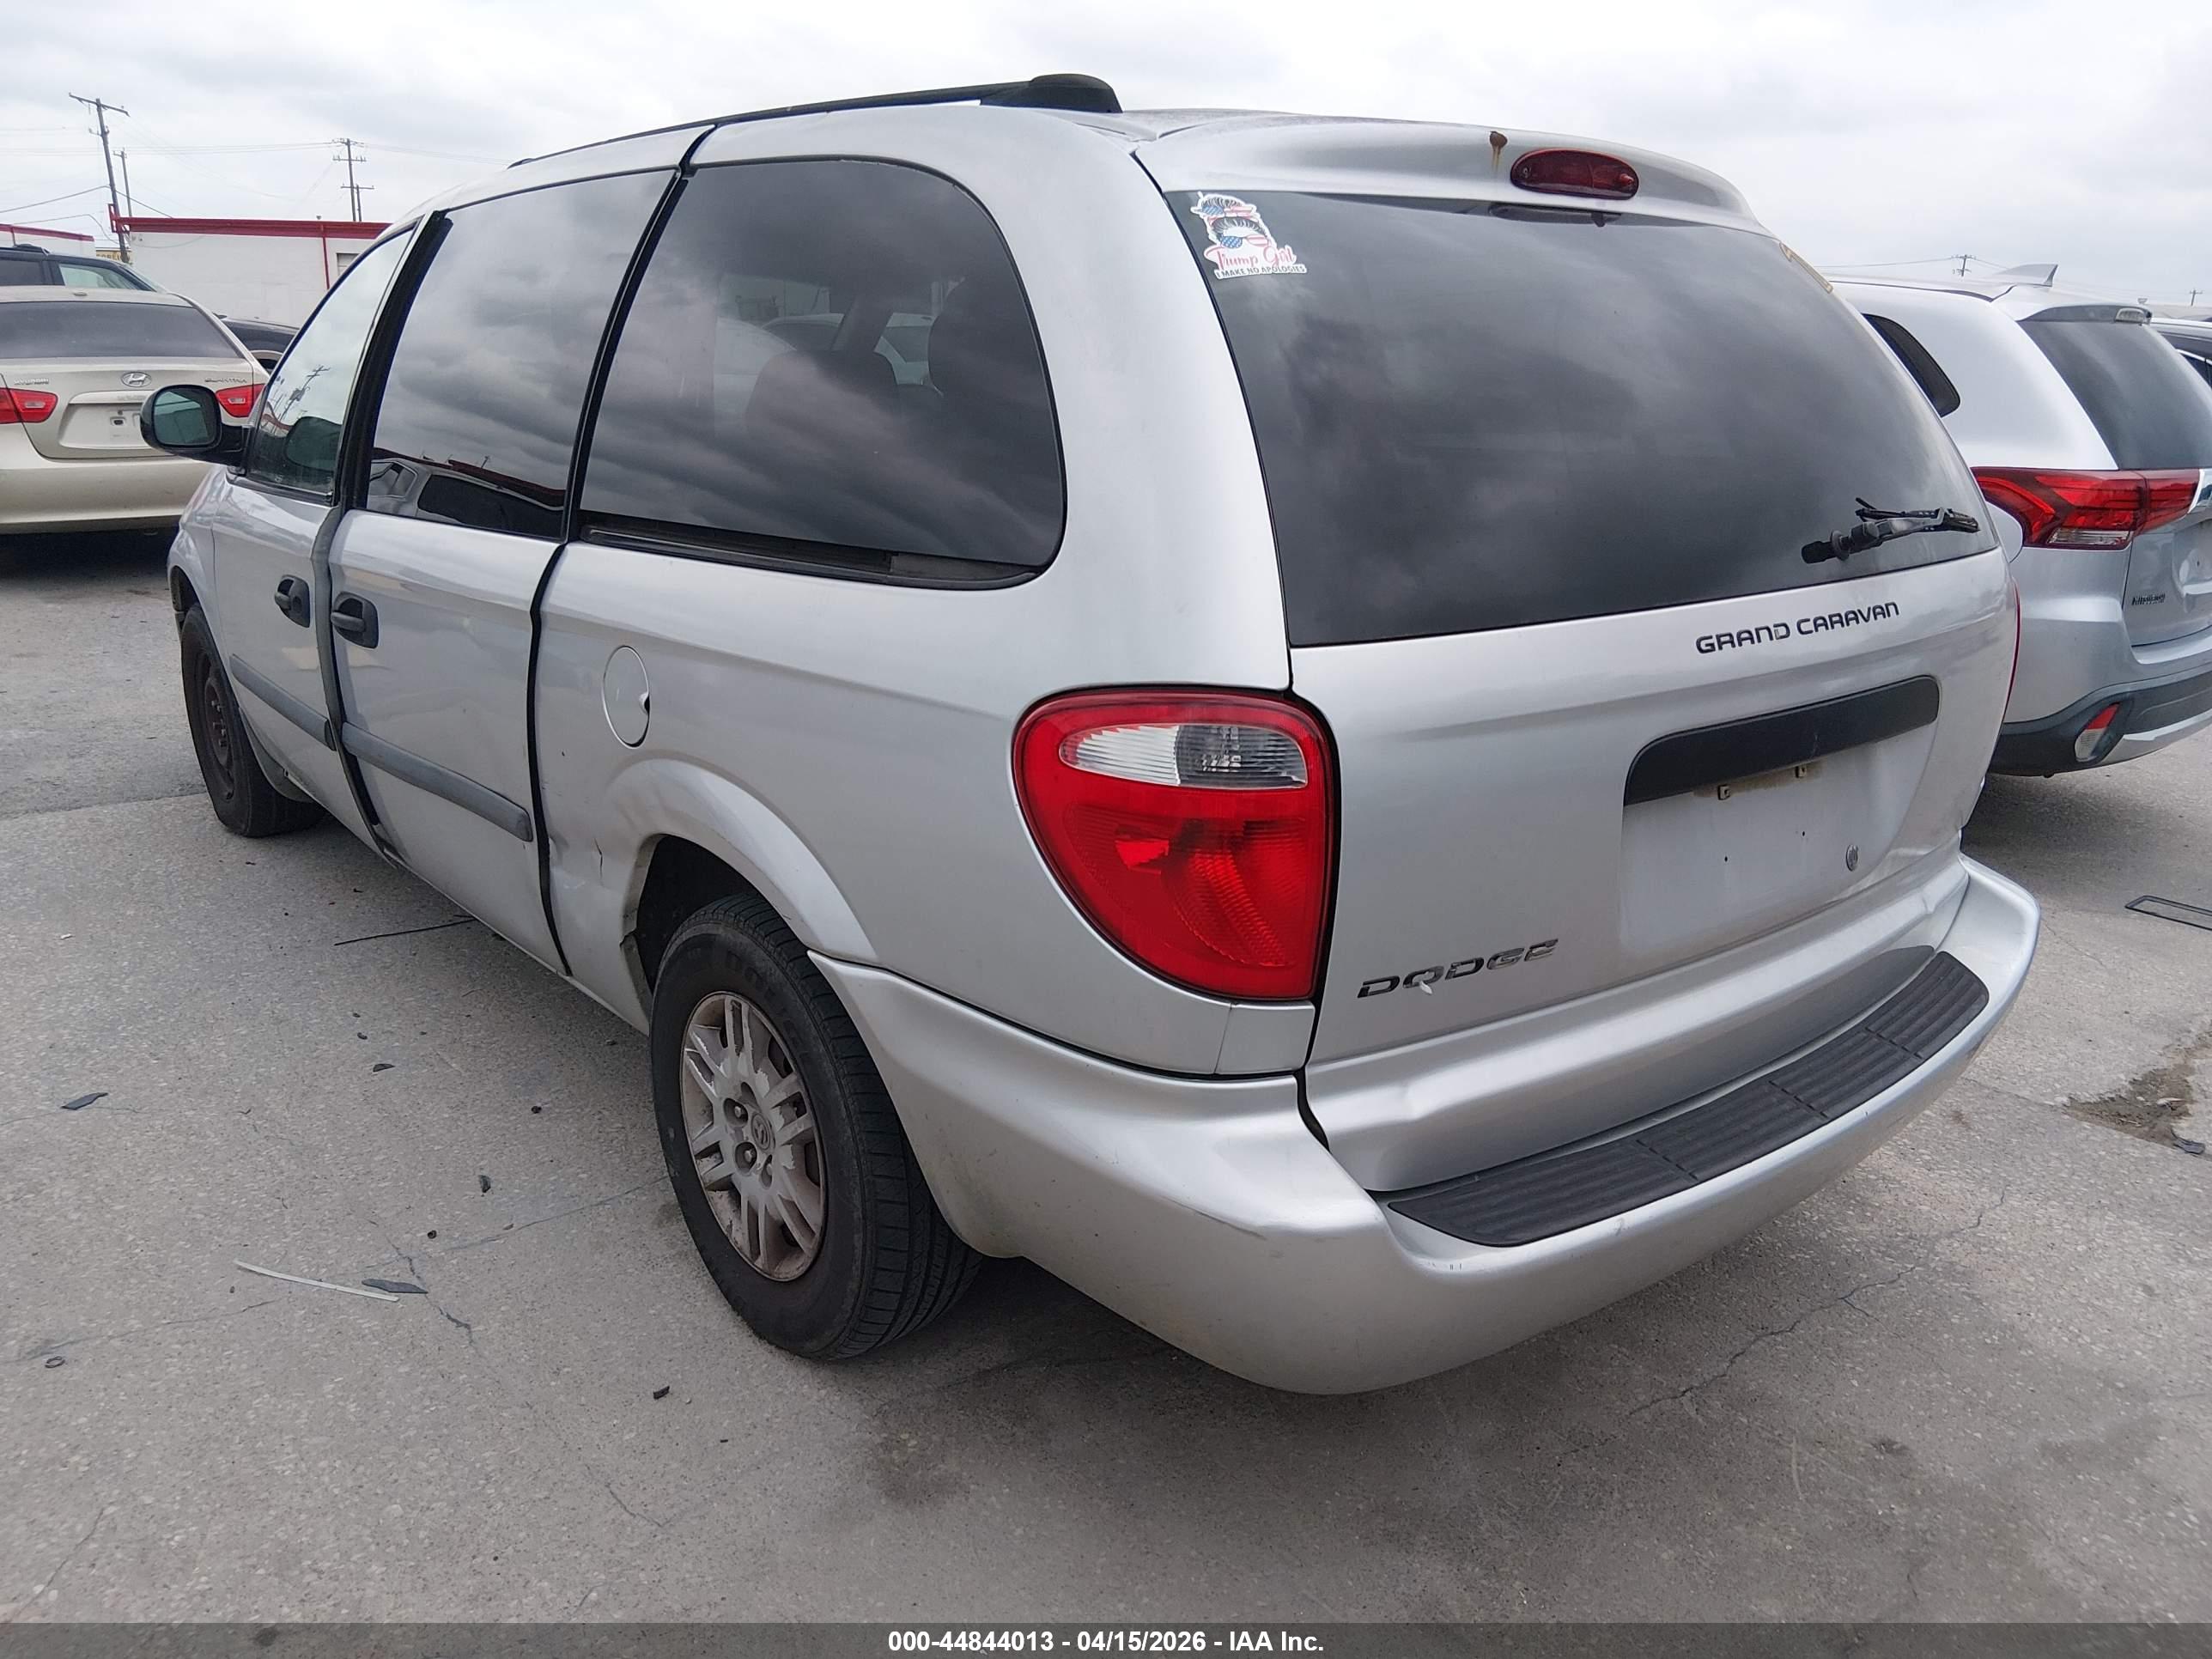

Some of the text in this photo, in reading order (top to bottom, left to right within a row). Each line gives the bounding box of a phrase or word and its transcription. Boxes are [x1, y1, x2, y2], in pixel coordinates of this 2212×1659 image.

[1206, 246, 1259, 270] Trump
[1221, 268, 1245, 277] MAKE
[1261, 265, 1305, 274] APOLOGIES
[1695, 601, 1899, 654] GRAND CARAVAN
[1357, 939, 1559, 999] DODGE
